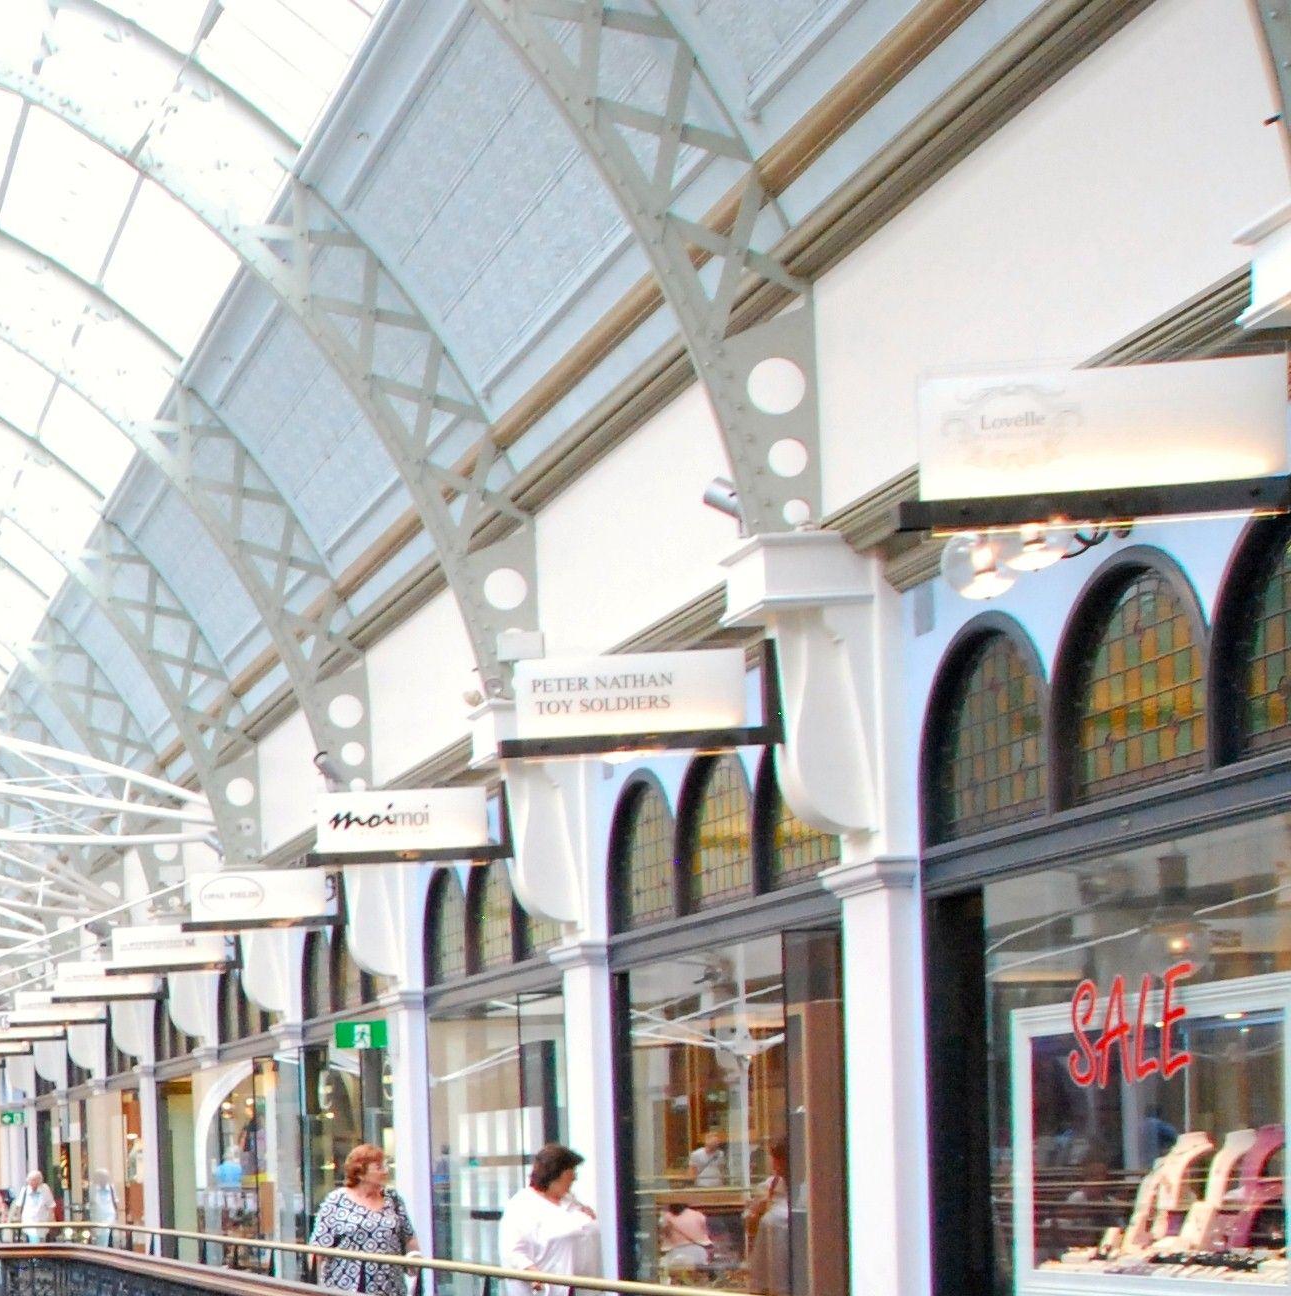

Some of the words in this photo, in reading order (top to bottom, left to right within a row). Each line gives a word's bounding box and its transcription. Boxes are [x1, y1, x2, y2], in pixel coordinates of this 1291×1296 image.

[980, 411, 1046, 430] Lovelle
[532, 676, 590, 694] PETER
[595, 671, 673, 690] NATHAN
[535, 699, 572, 716] TOY
[580, 694, 671, 714] SOLDIERS
[1068, 961, 1196, 1090] SALE
